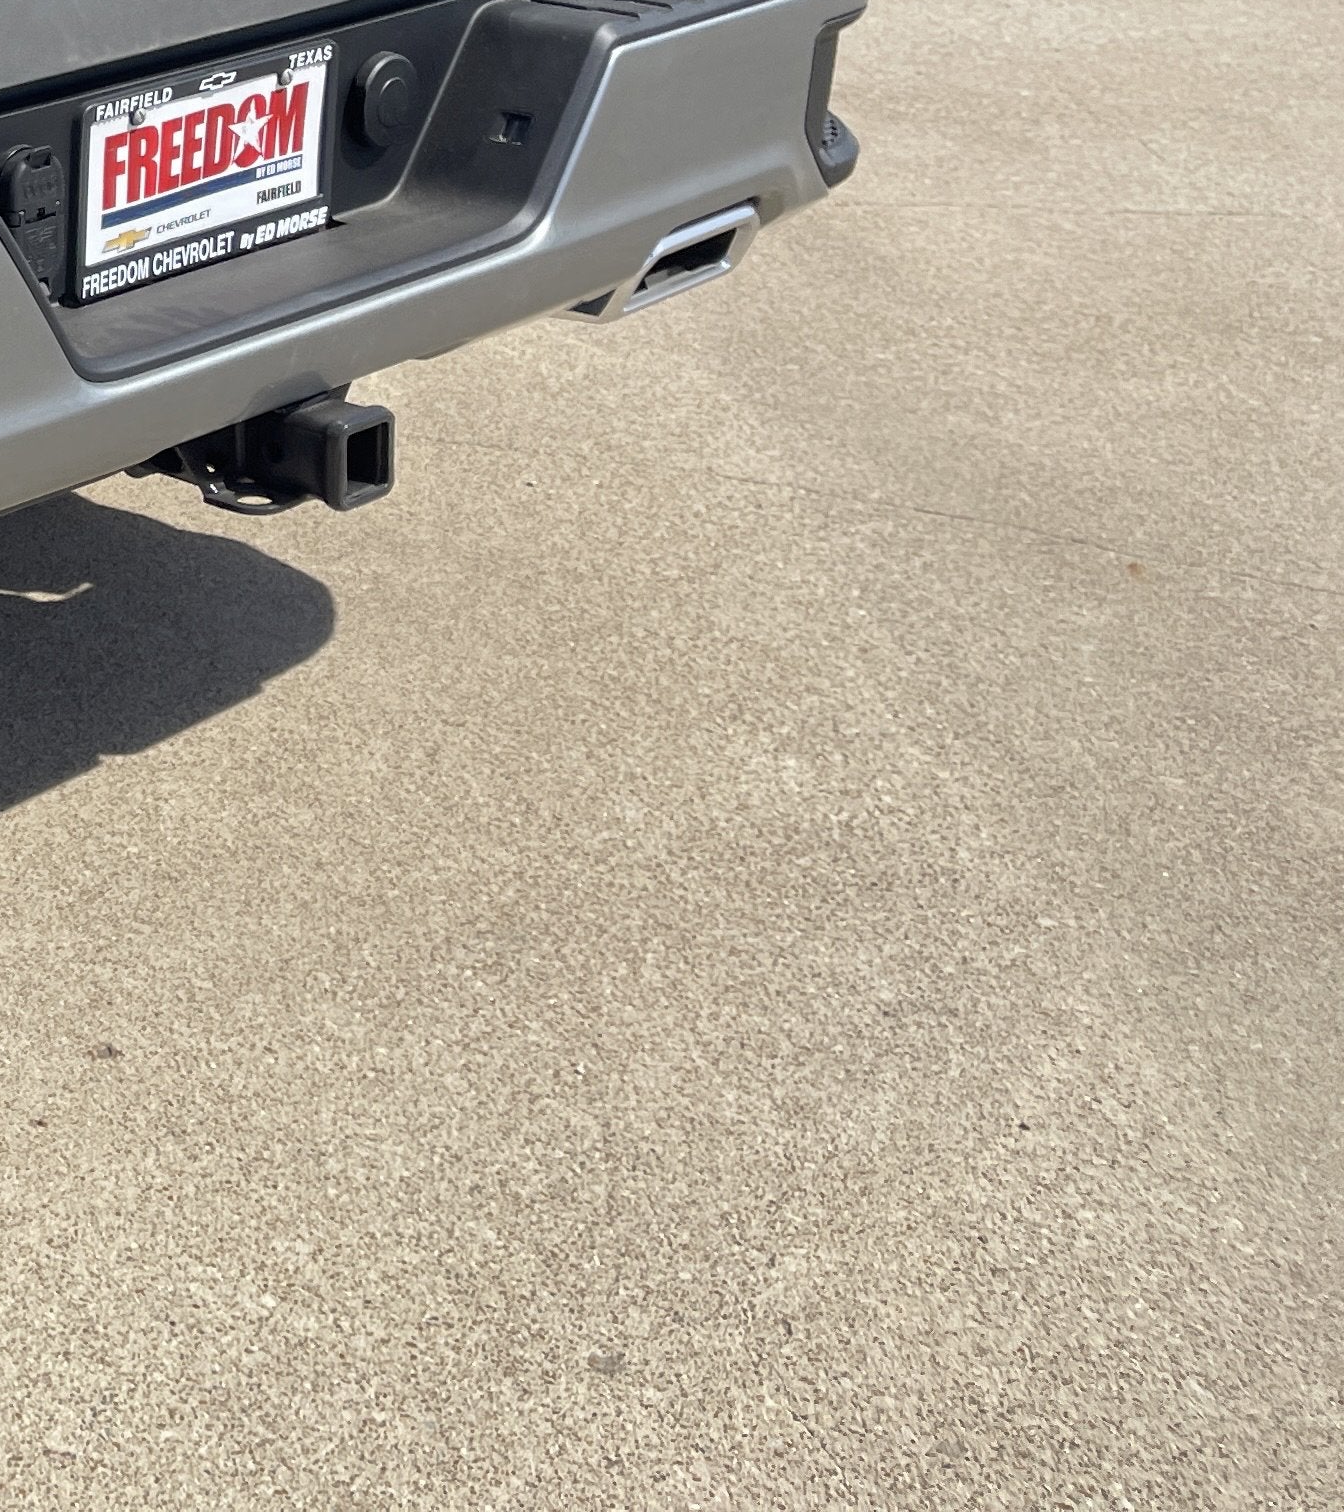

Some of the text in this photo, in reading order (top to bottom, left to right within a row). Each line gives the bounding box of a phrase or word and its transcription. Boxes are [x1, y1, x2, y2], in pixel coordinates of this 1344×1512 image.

[289, 45, 333, 69] TEXAS
[96, 87, 173, 122] FAIRFIELD
[102, 81, 309, 211] FREEDOM
[256, 180, 302, 204] FAIRFIELD
[156, 208, 212, 234] CHEVROLET
[82, 256, 150, 299] FREEDOM
[152, 231, 235, 276] CHEVROLET
[255, 222, 276, 245] ED
[276, 206, 329, 238] MORSE
